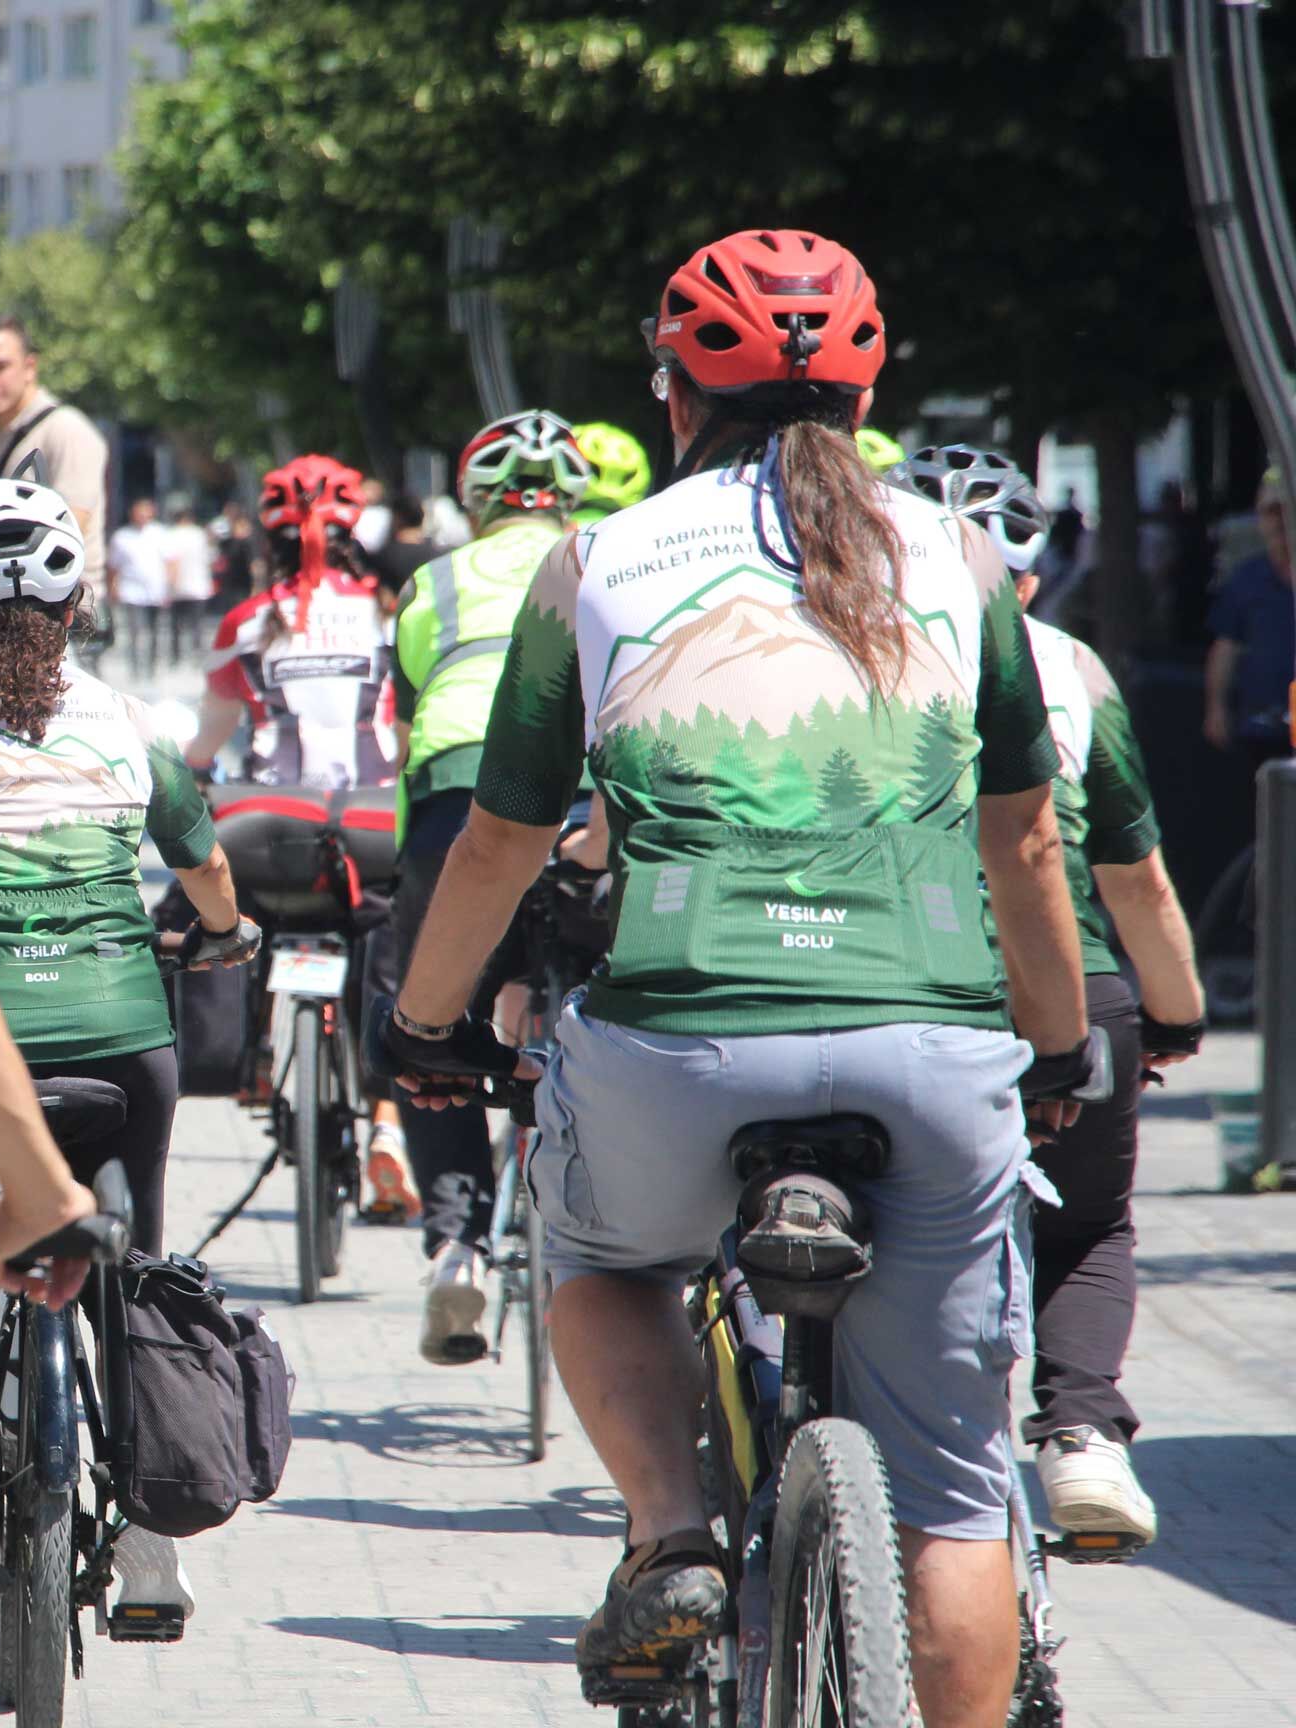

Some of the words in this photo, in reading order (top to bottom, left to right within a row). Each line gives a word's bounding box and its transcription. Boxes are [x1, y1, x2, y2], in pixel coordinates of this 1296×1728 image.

[606, 549, 692, 590] BİSİKLET
[700, 542, 785, 559] AMATR
[765, 902, 849, 924] YEŞİLAY
[783, 933, 834, 949] BOLU
[25, 971, 59, 982] BOLU
